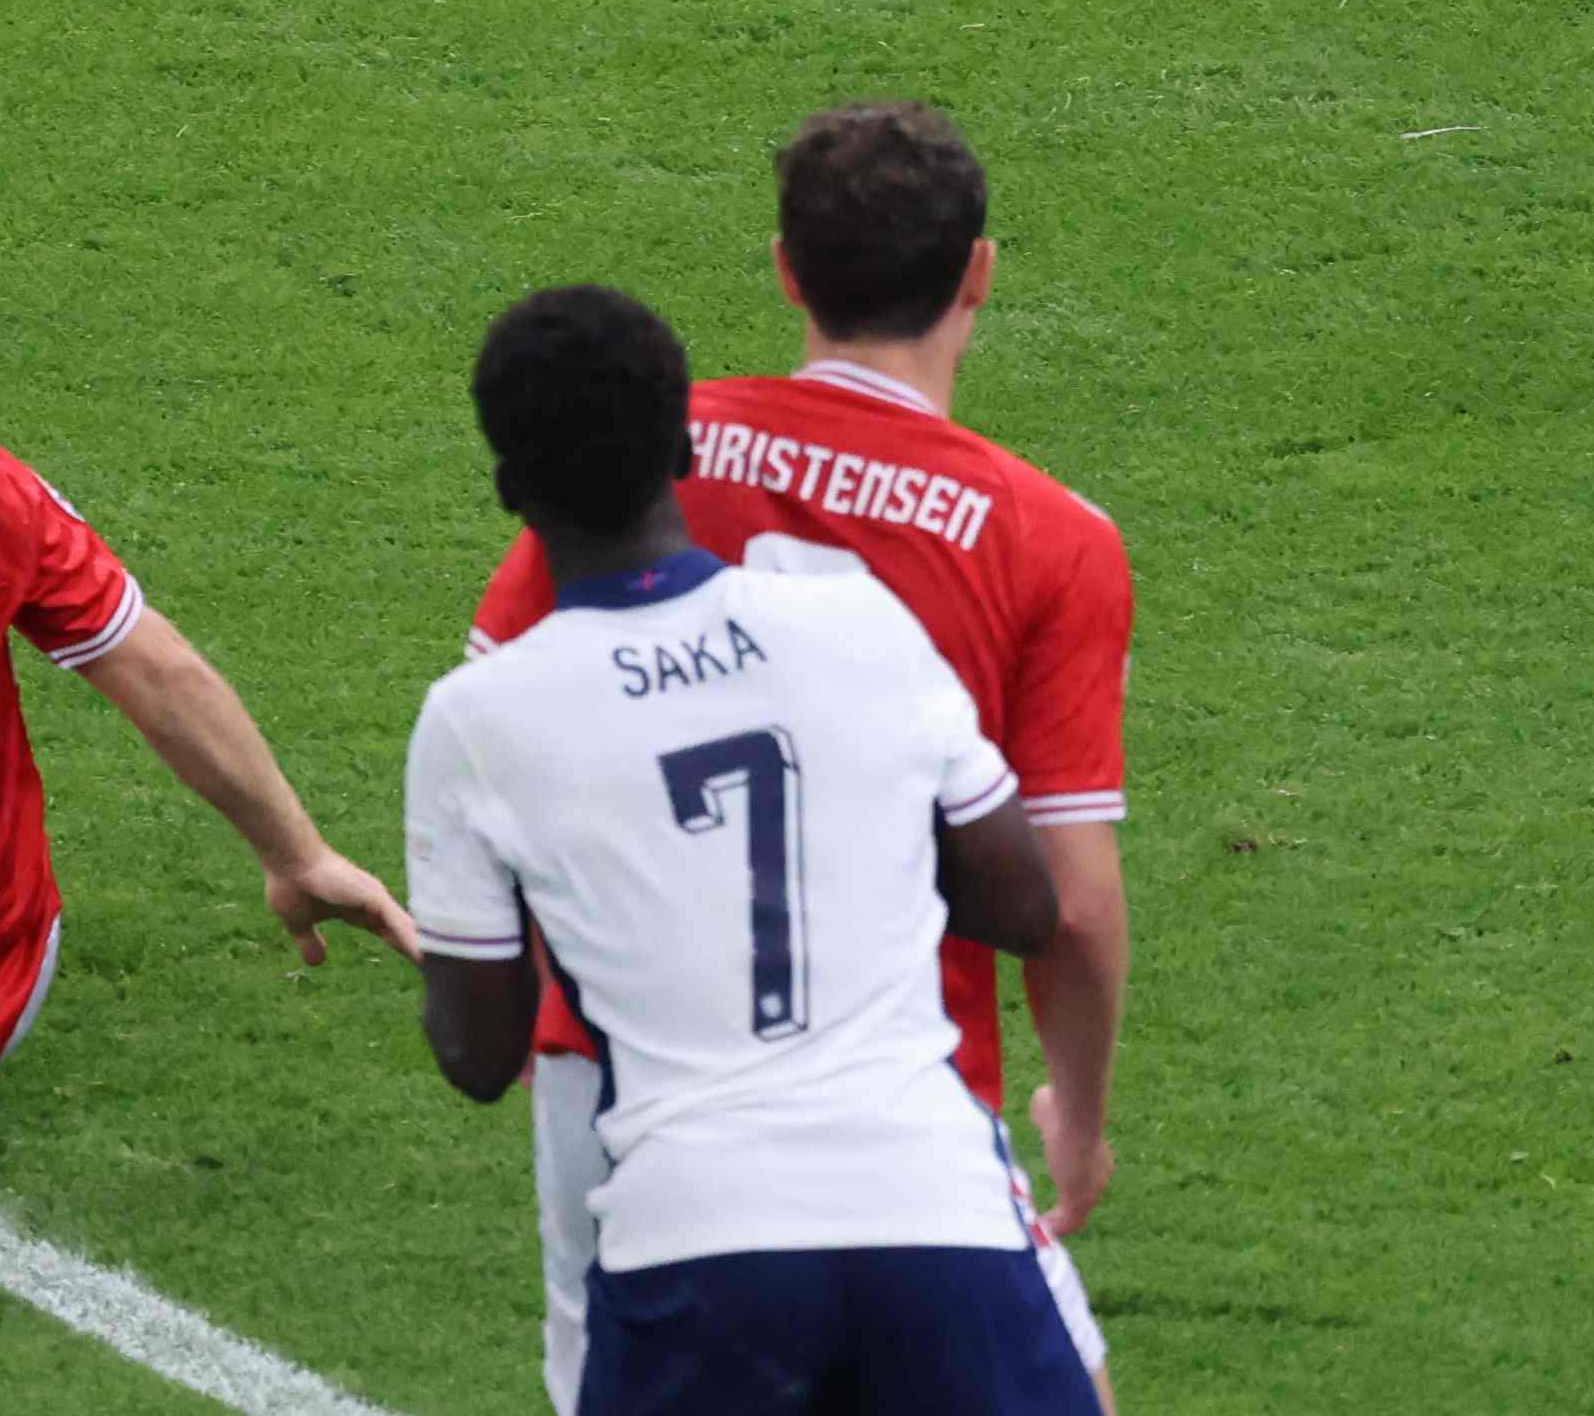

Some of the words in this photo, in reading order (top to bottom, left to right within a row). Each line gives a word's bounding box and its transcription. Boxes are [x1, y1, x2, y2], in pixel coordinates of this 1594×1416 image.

[688, 420, 993, 552] HRISTENSEN
[611, 618, 768, 699] SAKA
[658, 725, 808, 1042] 7
